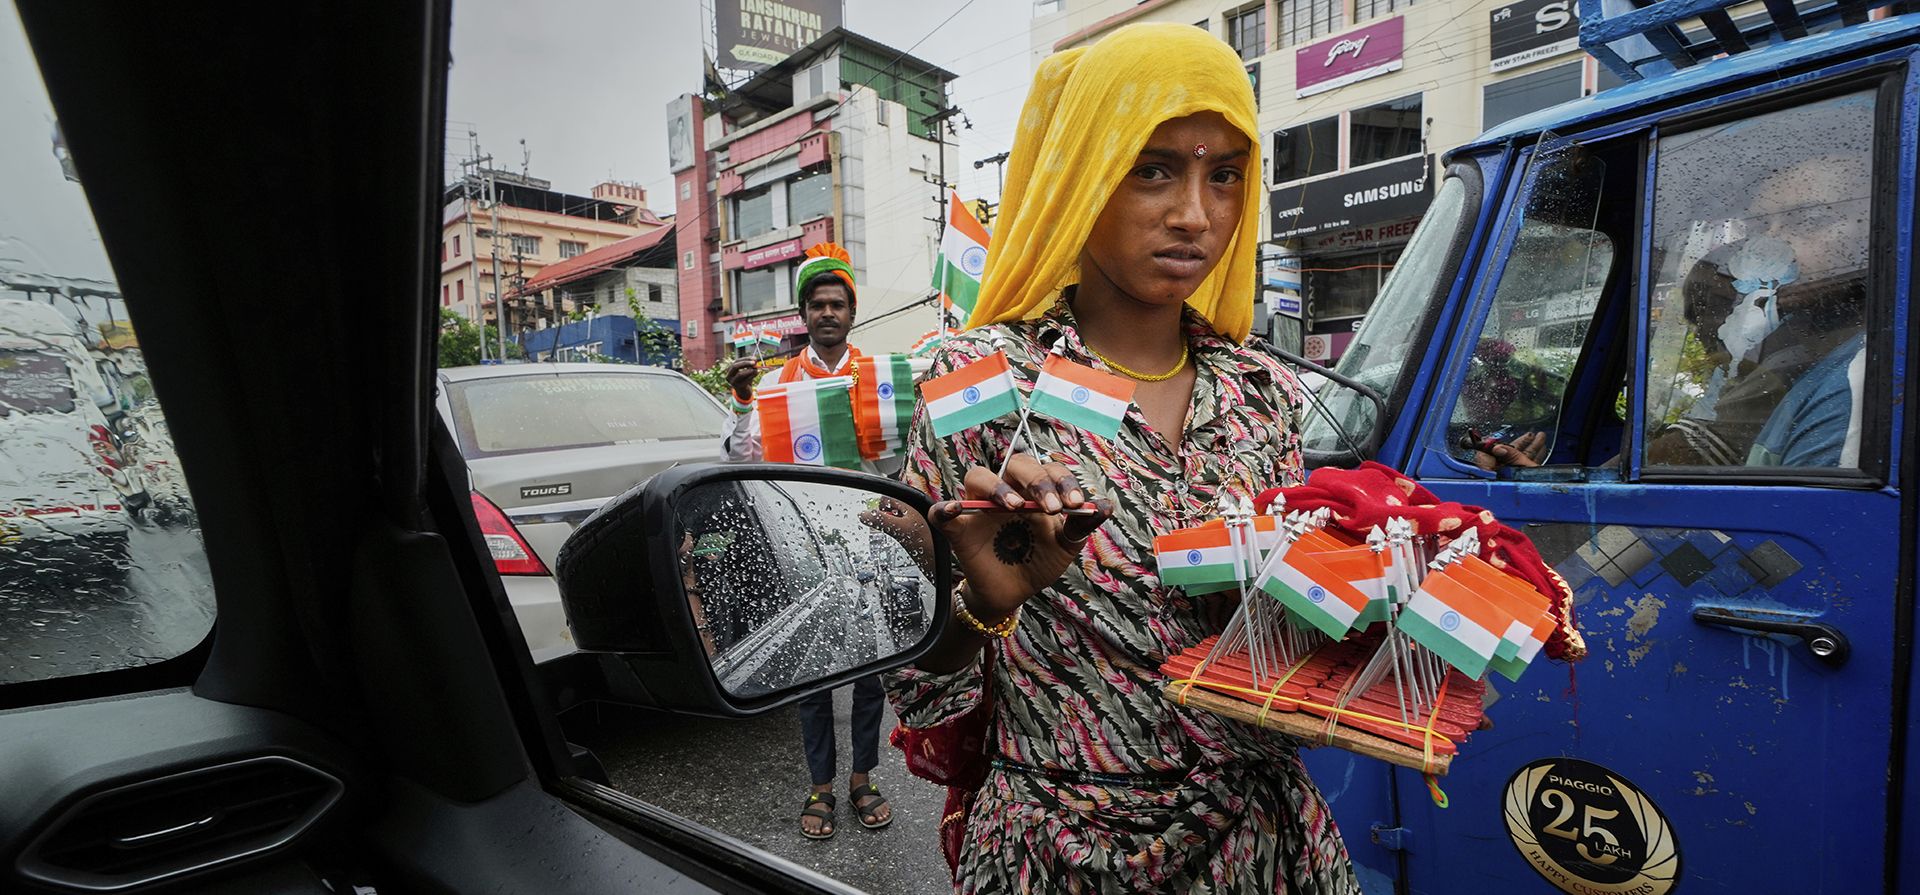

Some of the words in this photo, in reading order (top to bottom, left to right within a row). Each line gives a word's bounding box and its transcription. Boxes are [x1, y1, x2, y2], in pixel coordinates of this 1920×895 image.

[1323, 35, 1370, 67] Godrej
[1494, 57, 1511, 68] NEW
[1511, 52, 1531, 63] STAR
[1532, 45, 1560, 58] FREEZE
[1344, 178, 1425, 208] SAMSUNG
[1379, 220, 1422, 240] FREEZ
[1525, 309, 1539, 319] LG
[1549, 775, 1613, 795] PIAGGIO
[1540, 788, 1620, 865] 25
[1595, 841, 1632, 859] LAKH
[1529, 850, 1569, 884] HAPPY
